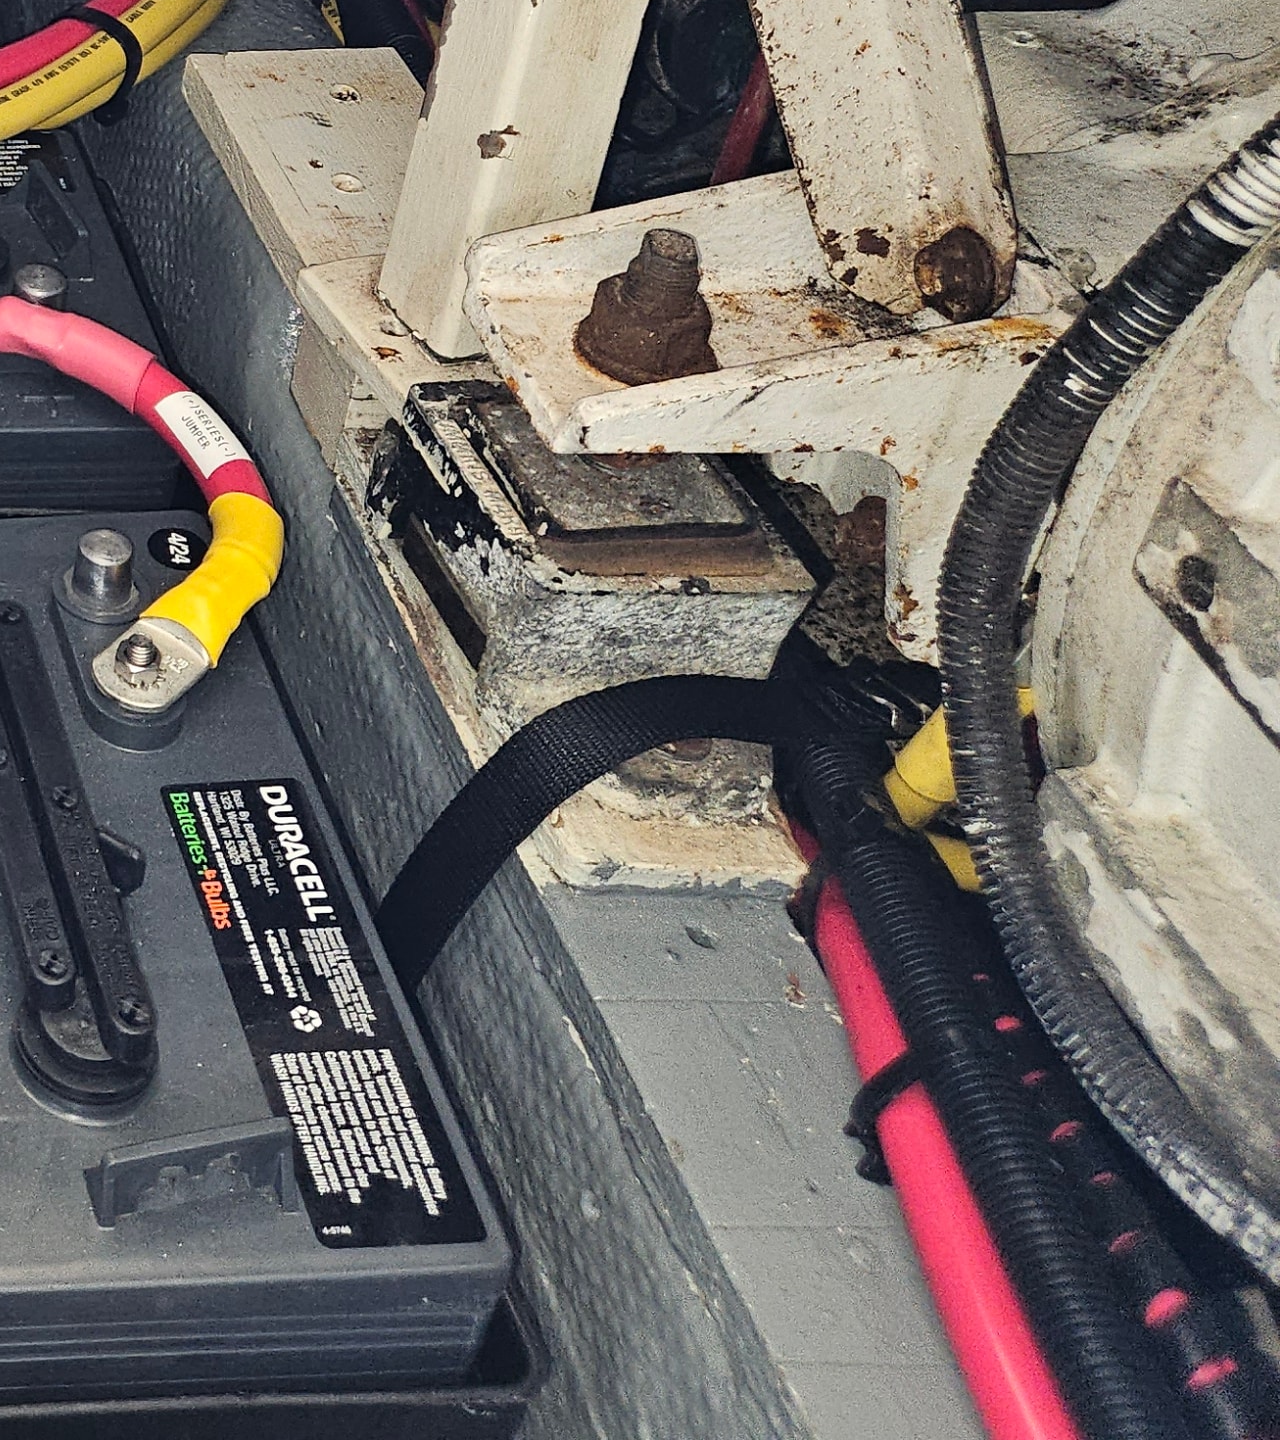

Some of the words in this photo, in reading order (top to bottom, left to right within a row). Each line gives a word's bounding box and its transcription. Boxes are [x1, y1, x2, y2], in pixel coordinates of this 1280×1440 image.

[181, 415, 211, 450] JUMPER
[167, 532, 191, 565] 4/24
[258, 785, 337, 923] DURACELL
